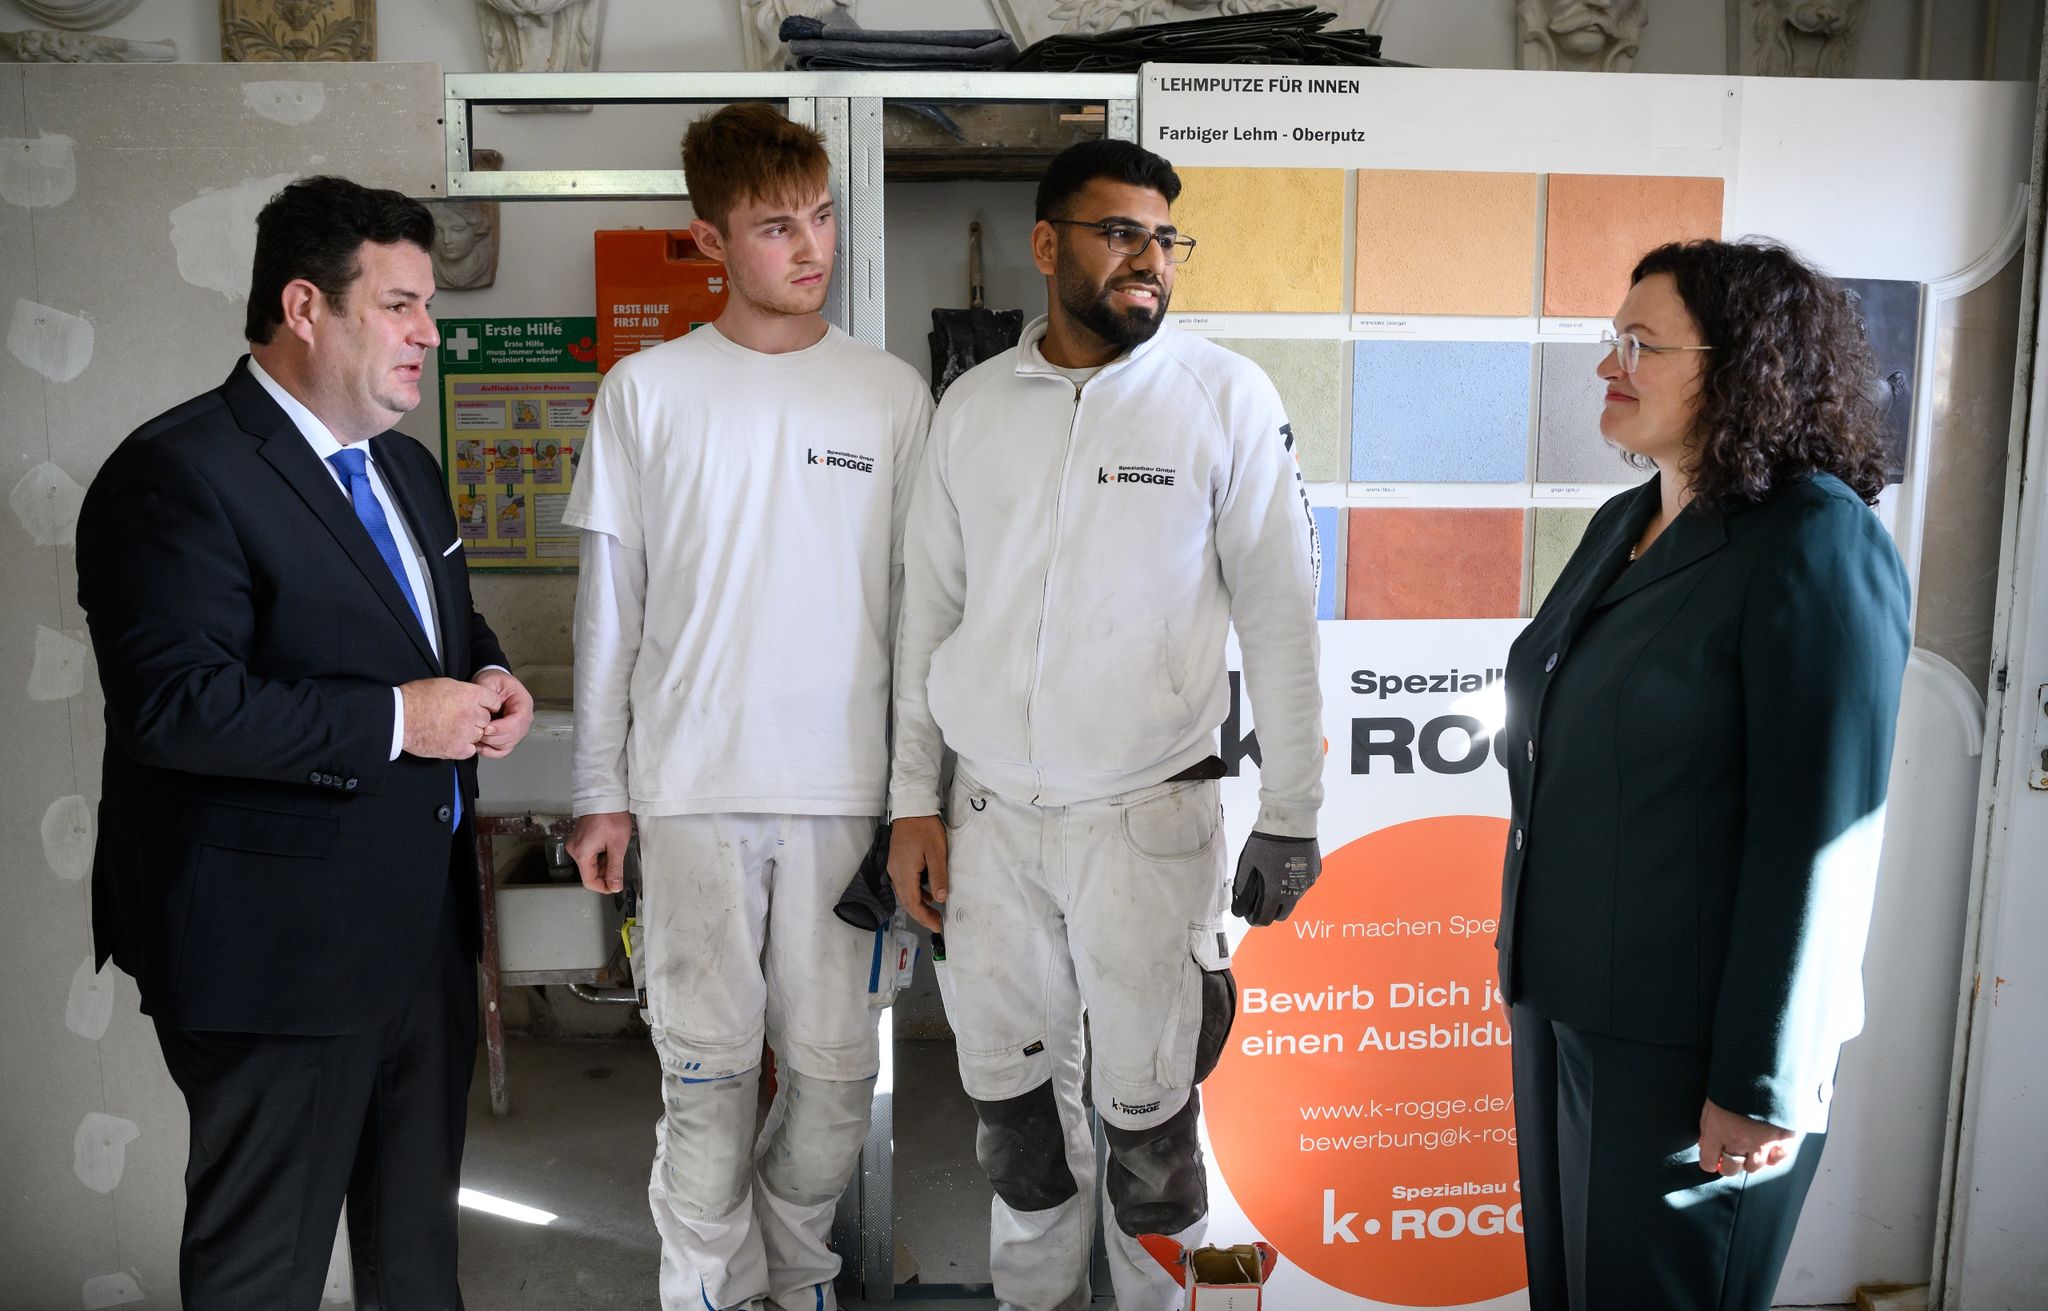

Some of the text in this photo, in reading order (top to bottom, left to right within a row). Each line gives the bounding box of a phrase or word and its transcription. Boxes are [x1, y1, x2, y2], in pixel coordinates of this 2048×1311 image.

[1161, 75, 1360, 94] LEHMPUTZE FÜR INNEN
[1159, 126, 1229, 144] Farbiger
[1233, 126, 1278, 141] Lehm
[1292, 127, 1365, 144] Oberputz
[613, 304, 669, 314] ERSTE HILFE
[485, 323, 562, 336] Erste Hilfe
[613, 317, 659, 327] FIRST AID
[504, 340, 523, 348] Erste
[535, 347, 562, 355] wieder
[491, 355, 558, 364] trainiert werden!
[807, 448, 873, 473] k ROGGE
[1098, 467, 1175, 486] k ROGGE
[1350, 668, 1504, 700] Spezial
[1351, 714, 1508, 775] RO
[1294, 915, 1500, 939] Wir machen Spe
[1243, 984, 1375, 1013] Bewirb
[1390, 980, 1470, 1008] Dich
[1241, 1030, 1344, 1056] einen
[1122, 1104, 1160, 1115] ROGGE
[1300, 1094, 1514, 1120] www.k-rogge.de/
[1391, 1181, 1506, 1200] Spezialbau
[1323, 1189, 1359, 1244] k
